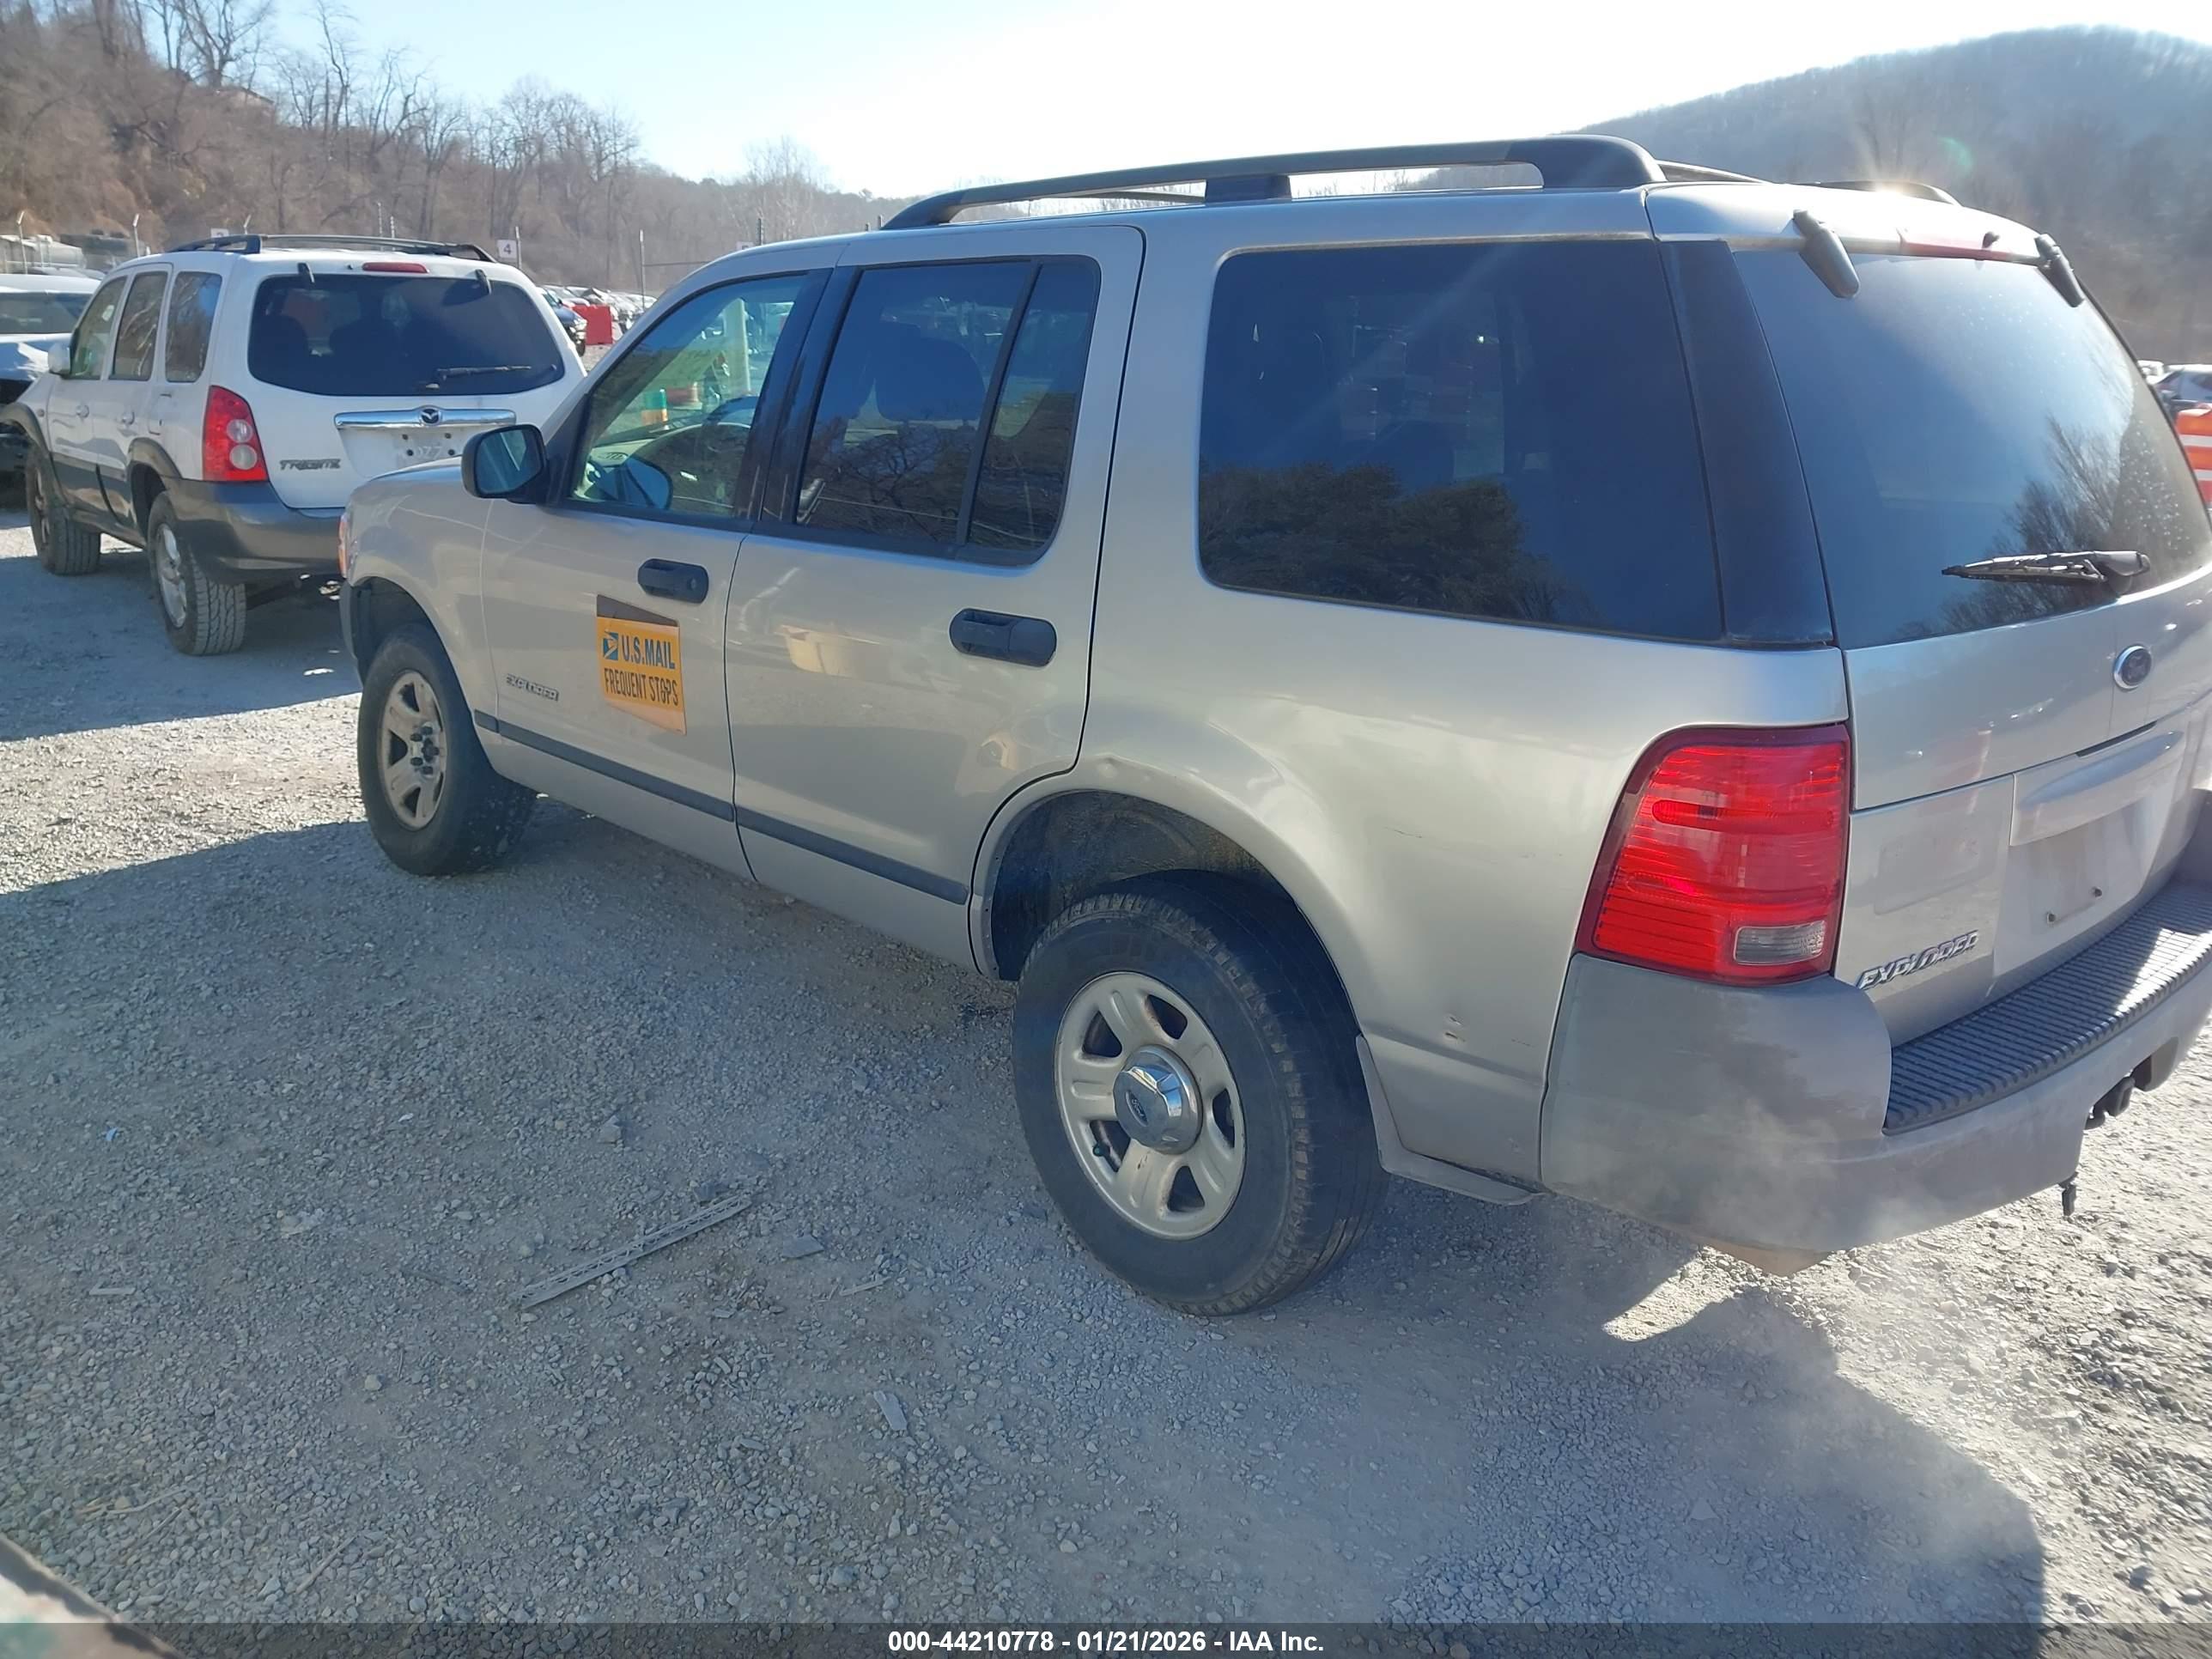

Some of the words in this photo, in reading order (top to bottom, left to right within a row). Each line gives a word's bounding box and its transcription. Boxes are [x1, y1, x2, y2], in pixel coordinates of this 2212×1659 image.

[503, 244, 512, 255] 4
[605, 668, 647, 700] FREQUENT
[648, 677, 678, 706] STOPS
